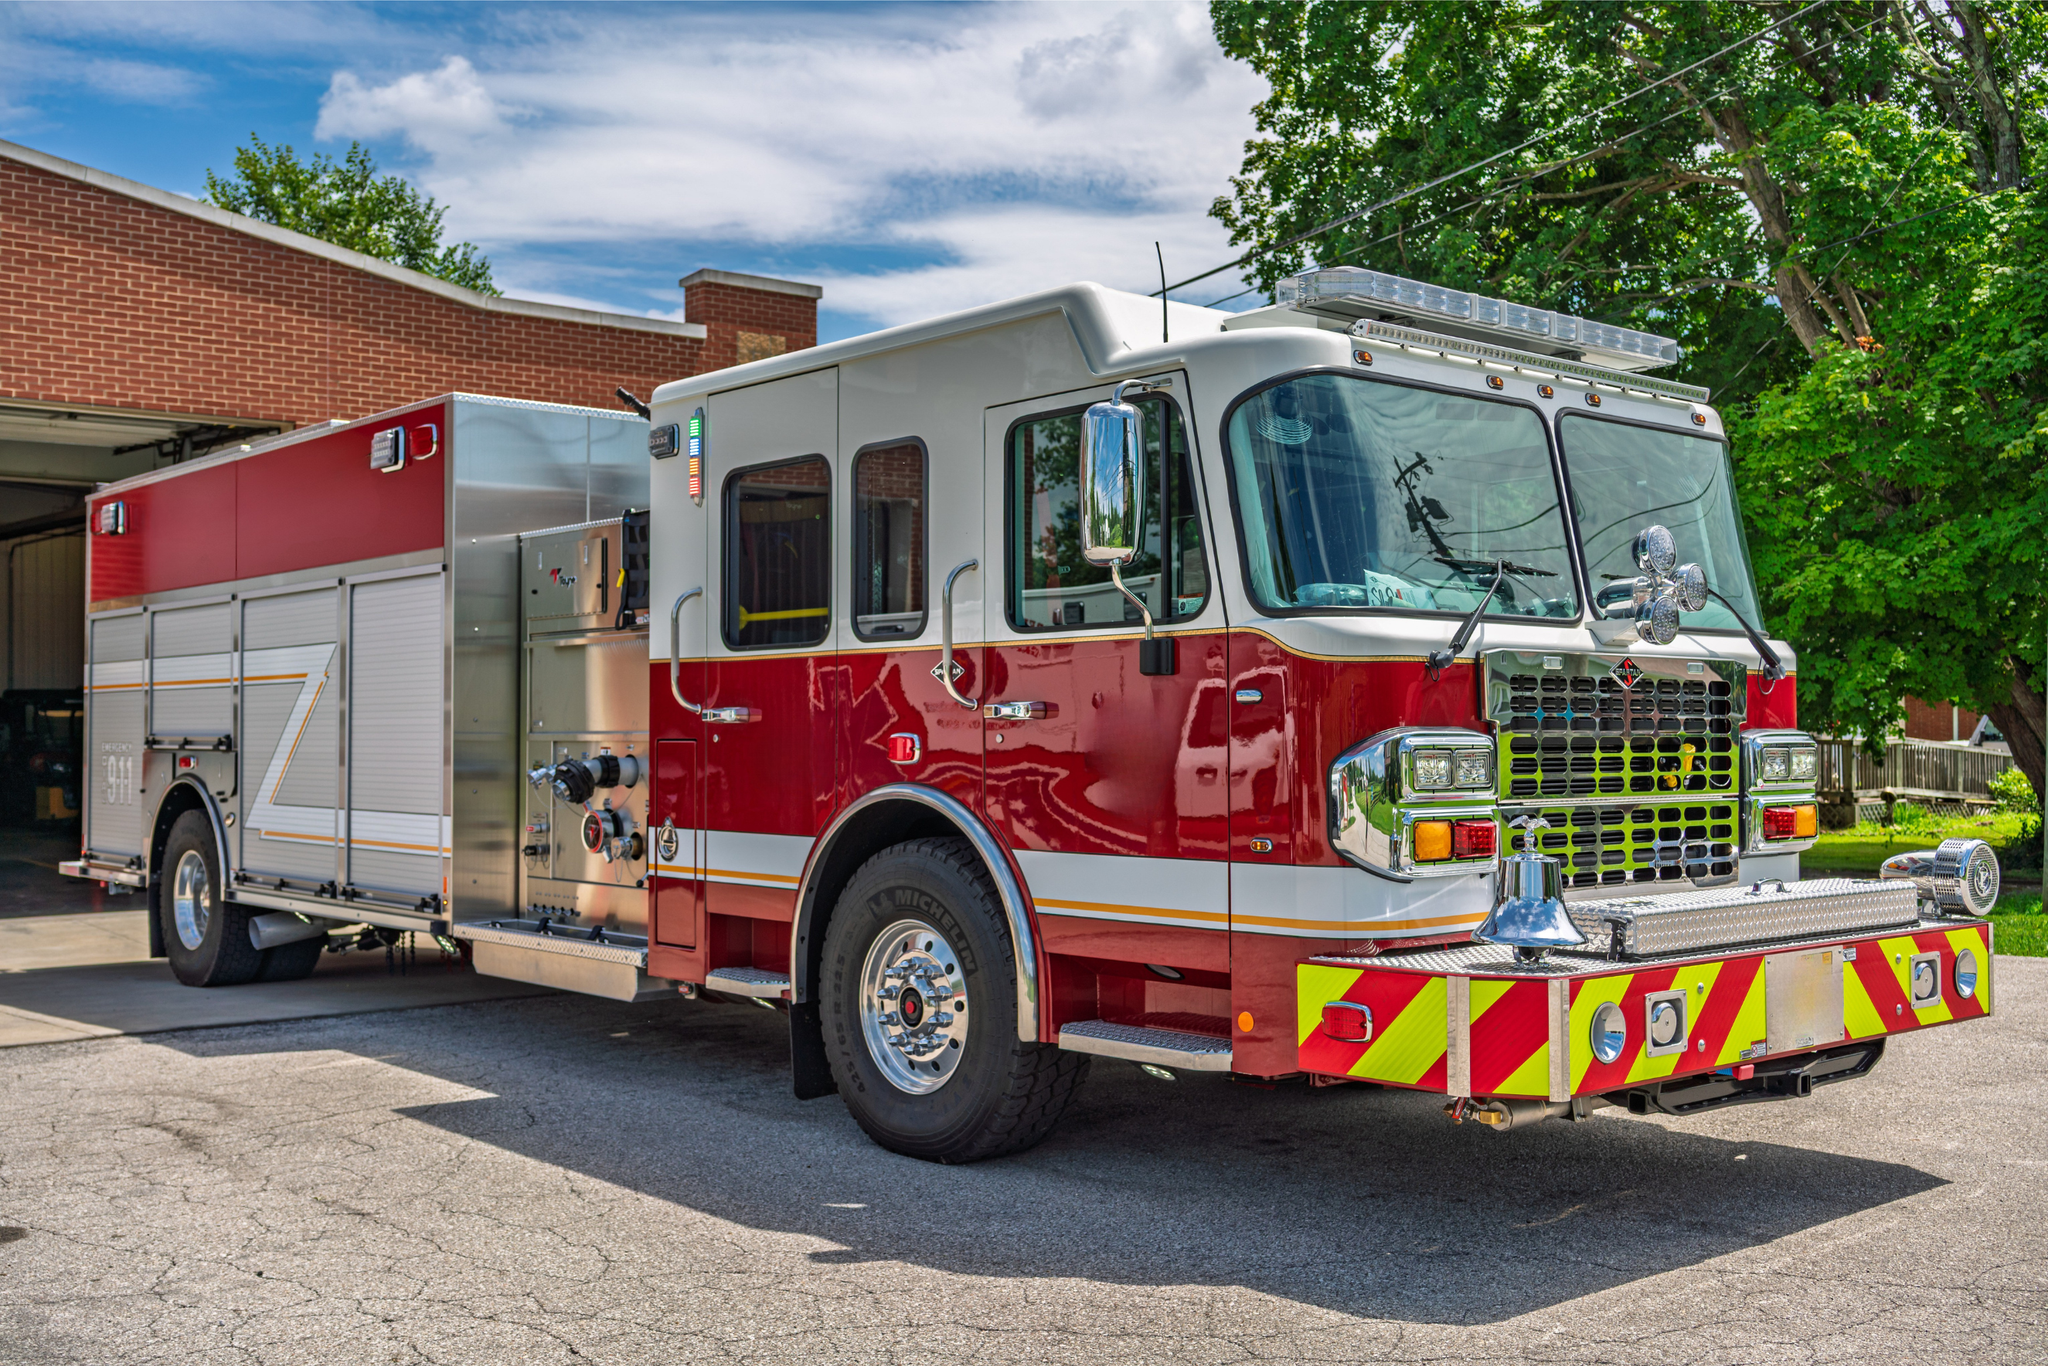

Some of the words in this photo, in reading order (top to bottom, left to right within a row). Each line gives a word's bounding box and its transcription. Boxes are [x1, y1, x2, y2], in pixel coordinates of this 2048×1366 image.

[1616, 668, 1641, 676] SPARTAN
[102, 742, 132, 752] EMERGENCY
[895, 889, 976, 970] MICHELIN
